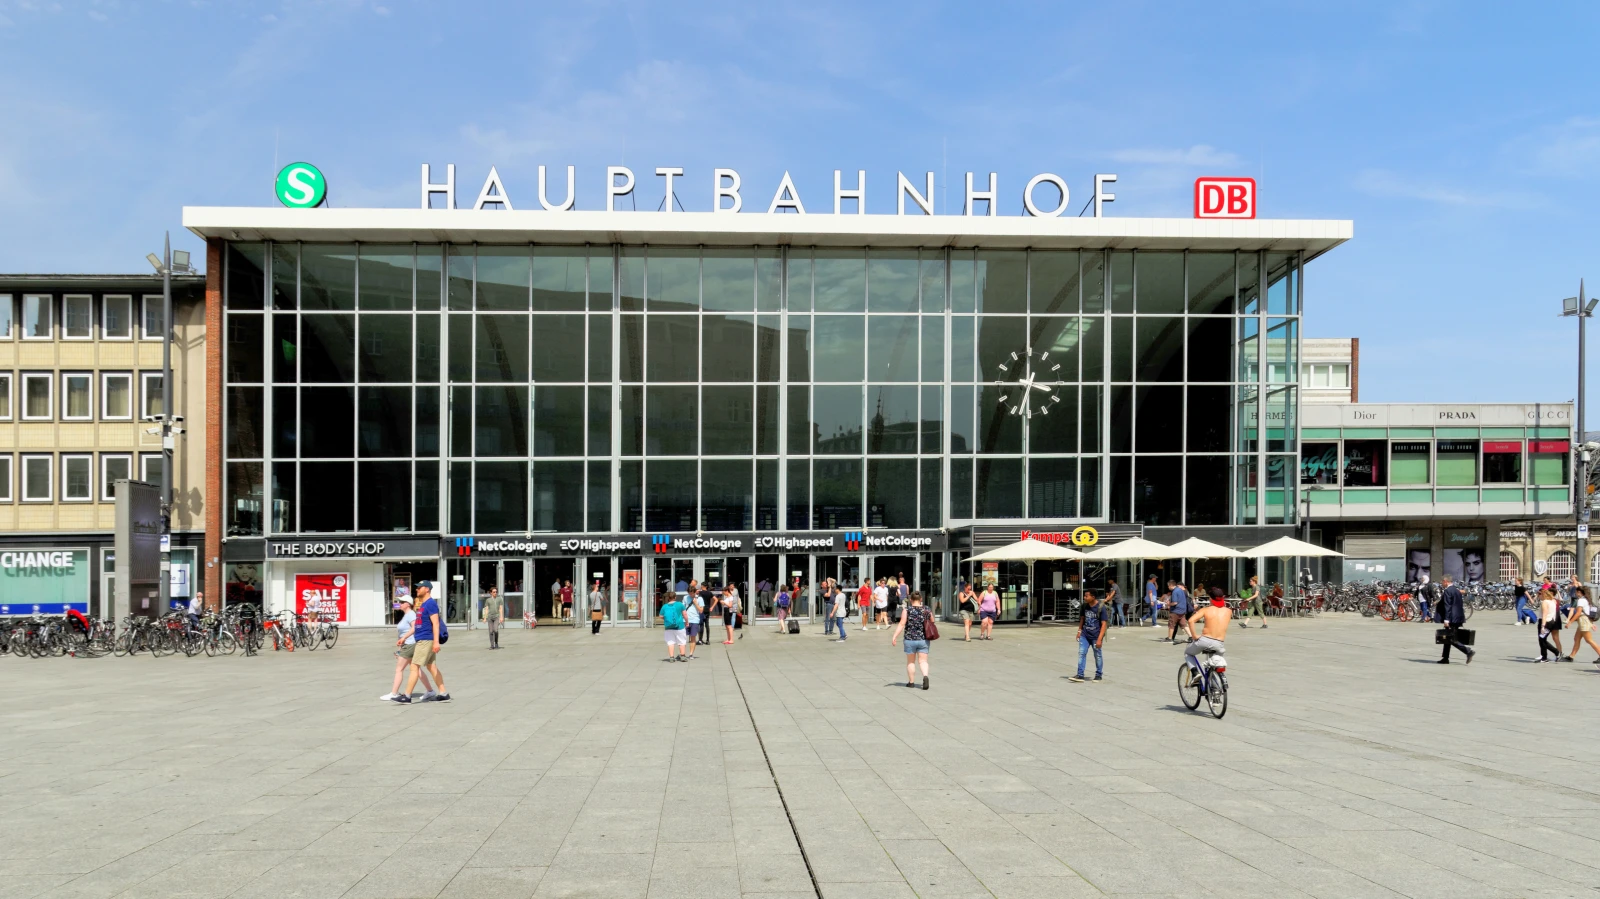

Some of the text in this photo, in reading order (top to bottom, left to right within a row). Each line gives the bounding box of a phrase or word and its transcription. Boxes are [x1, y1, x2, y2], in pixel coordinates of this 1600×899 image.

[284, 167, 316, 205] S
[421, 163, 1117, 217] HAUPTBAHNHOF
[1203, 184, 1248, 214] DB
[1353, 410, 1377, 420] Dior
[1439, 411, 1476, 419] PRADA
[1527, 411, 1570, 419] GUCCI
[774, 536, 834, 549] Highspeed
[866, 535, 932, 547] NetCologne
[1021, 529, 1070, 545] Kamps
[1451, 532, 1479, 544] Douglas
[272, 542, 385, 554] THE BODY SHOP
[478, 539, 547, 553] NetCologne
[580, 539, 641, 552] Highspeed
[674, 538, 742, 550] NetCologne
[1, 552, 73, 568] CHANGE
[302, 588, 341, 600] SALE
